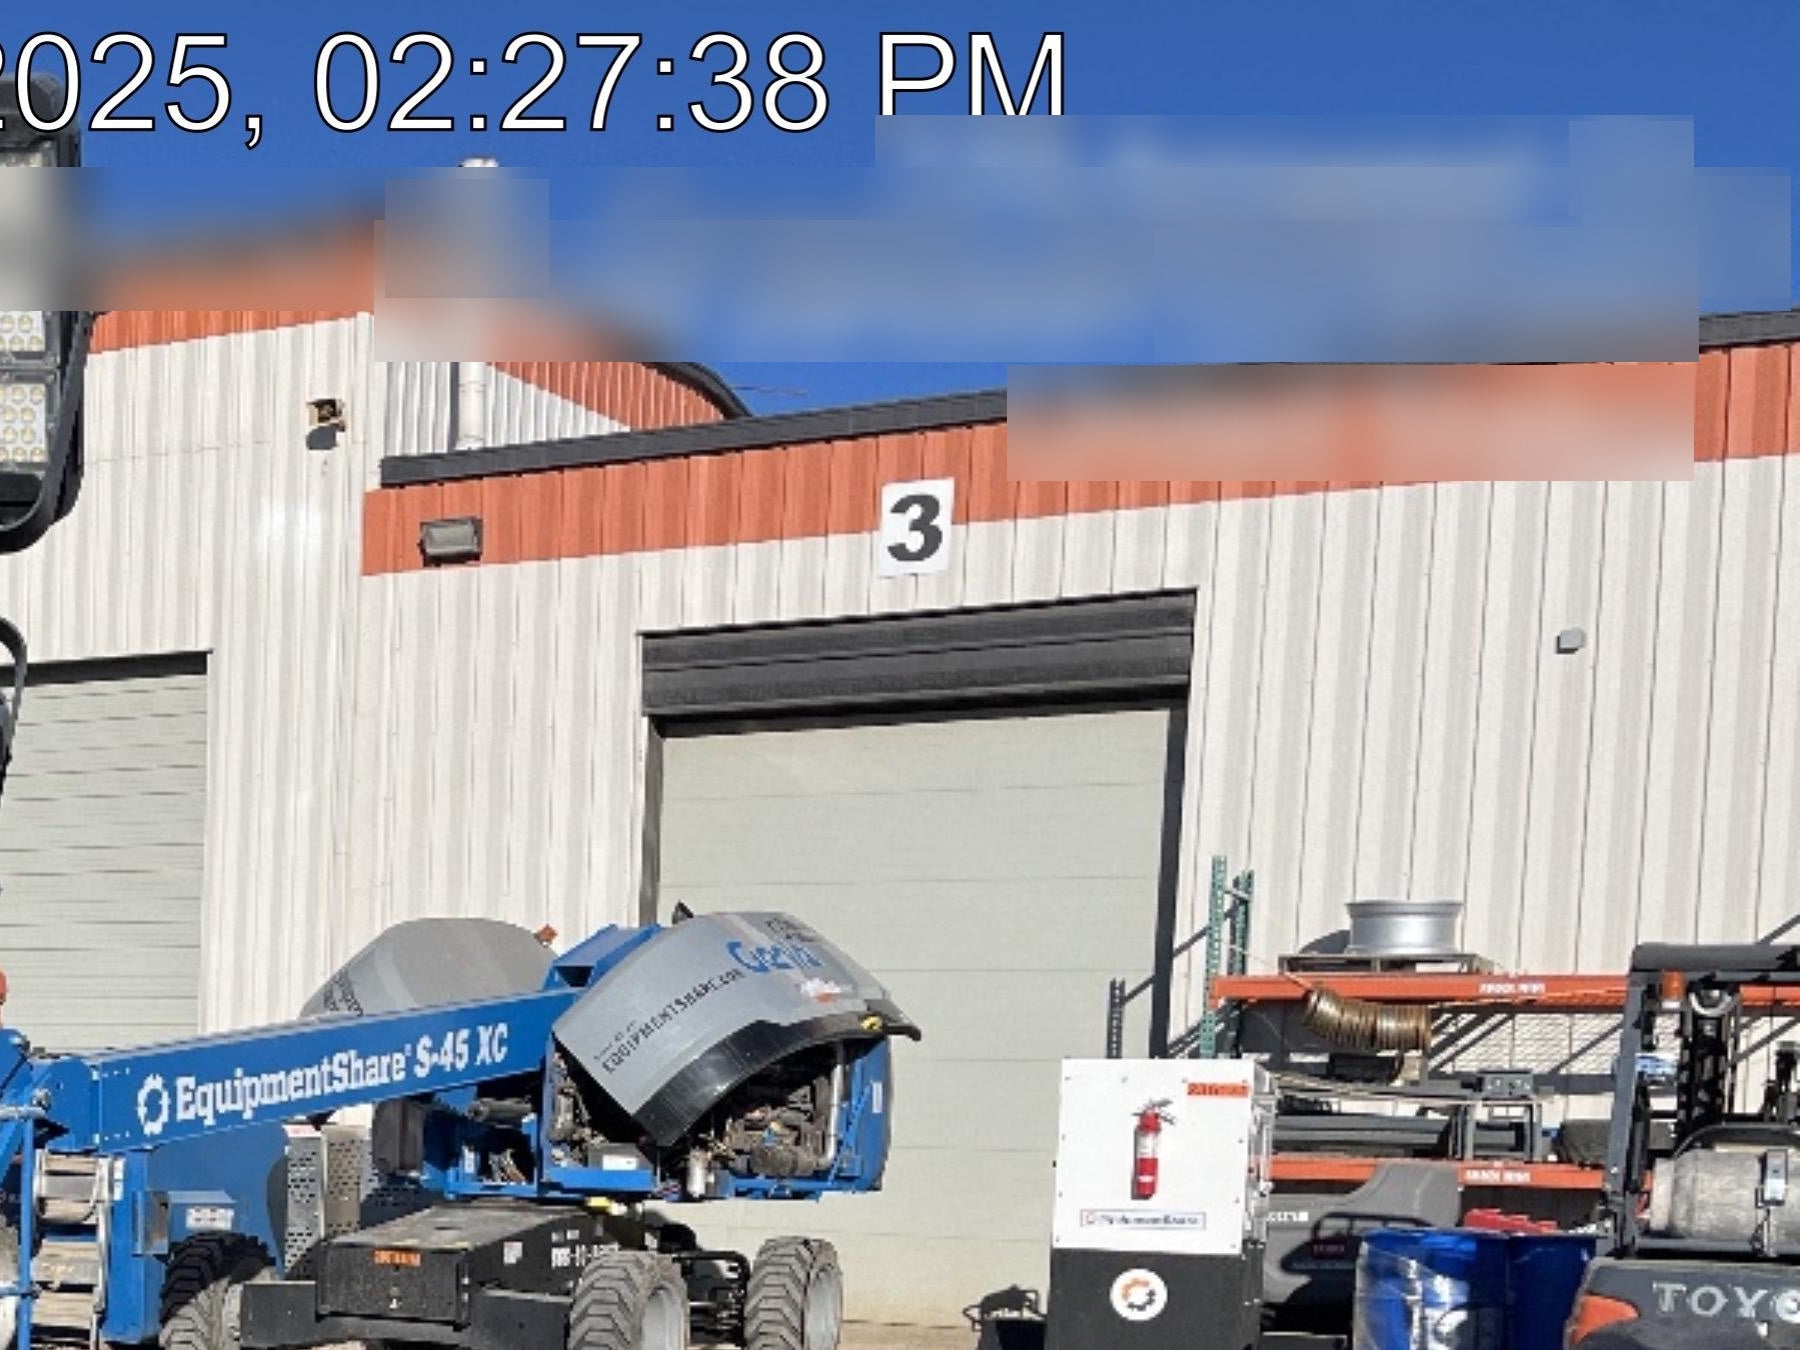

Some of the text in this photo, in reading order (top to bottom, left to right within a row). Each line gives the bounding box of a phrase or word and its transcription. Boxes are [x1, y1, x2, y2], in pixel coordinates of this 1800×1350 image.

[887, 493, 943, 562] 3
[176, 1023, 509, 1127] EquipmentShare S-45 XC
